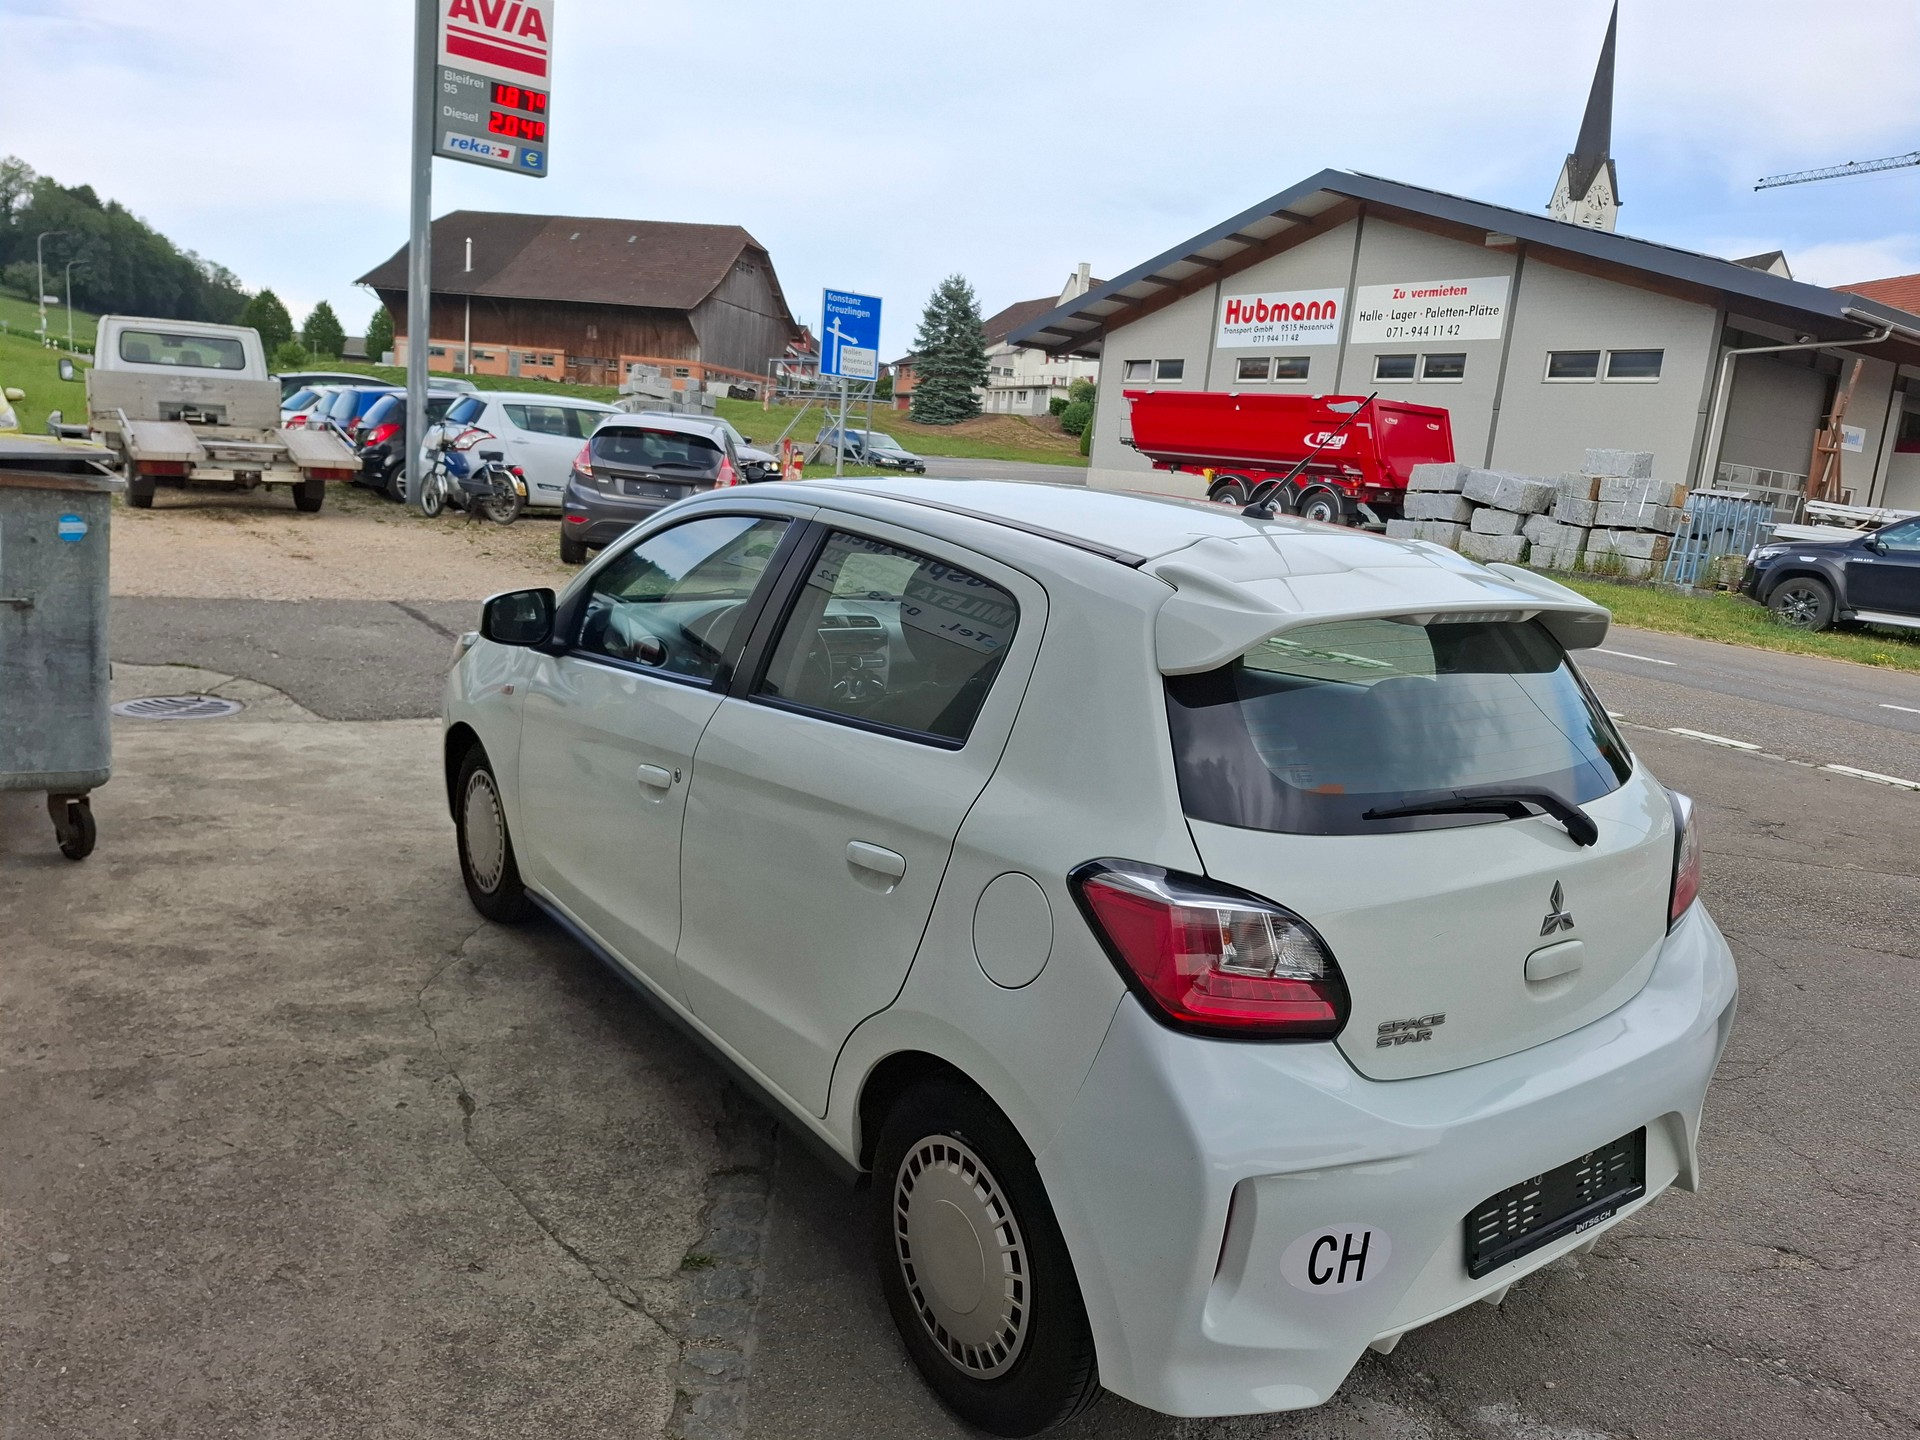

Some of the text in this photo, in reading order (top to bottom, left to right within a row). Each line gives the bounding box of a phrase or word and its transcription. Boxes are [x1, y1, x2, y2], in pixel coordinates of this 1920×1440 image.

[444, 70, 485, 89] Bleifrei
[443, 82, 458, 95] 95
[443, 106, 479, 123] Diesel
[827, 292, 862, 306] Konstanz
[1393, 285, 1468, 300] Zu vermieten
[827, 303, 871, 318] Kreuzlingen
[1225, 298, 1337, 325] Hubmann
[1359, 304, 1500, 323] Halle Lager Paletten-Plätze
[1224, 322, 1335, 336] Transport GmbH 9515 Hosenruck
[1447, 324, 1461, 336] 42
[1252, 335, 1266, 343] 071
[1266, 334, 1279, 343] 944
[1377, 1012, 1447, 1036] SPACE
[1375, 1028, 1433, 1049] STAR
[1307, 1231, 1372, 1286] CH
